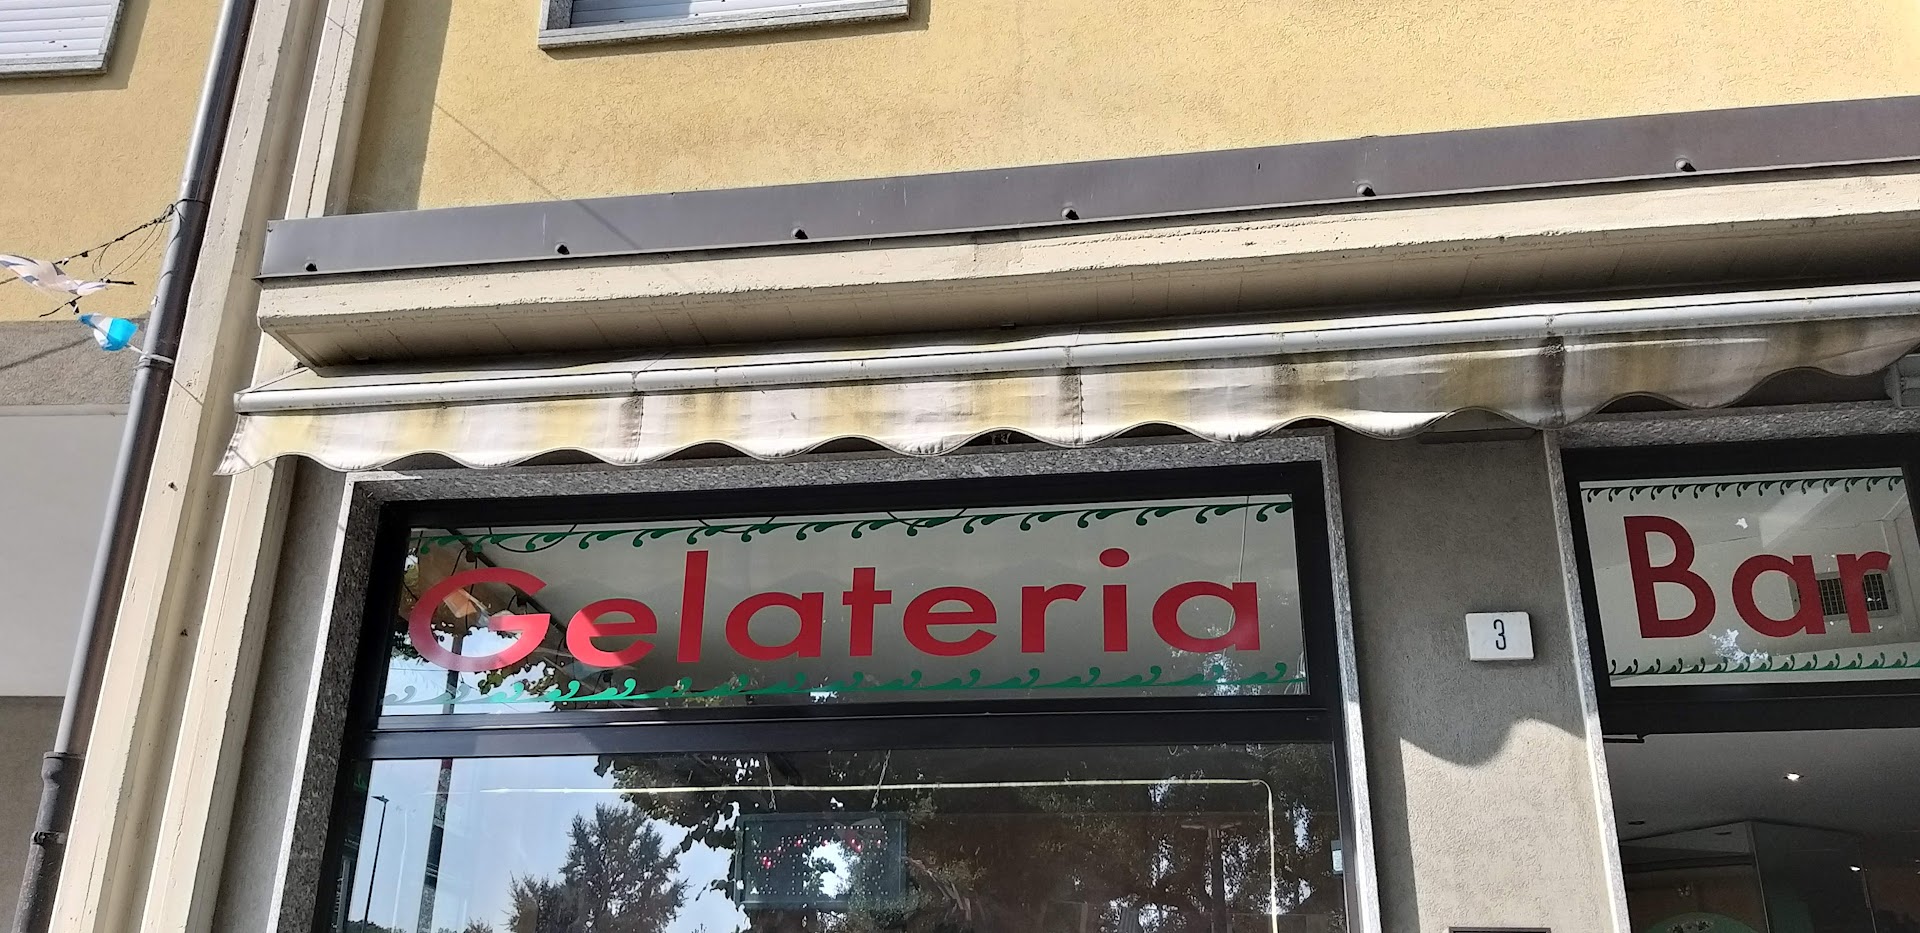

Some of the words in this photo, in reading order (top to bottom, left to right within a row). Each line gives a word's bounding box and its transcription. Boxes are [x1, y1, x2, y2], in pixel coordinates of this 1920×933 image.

[408, 548, 1260, 672] Gelateria
[1493, 618, 1507, 651] 3
[1623, 515, 1892, 639] Bar
